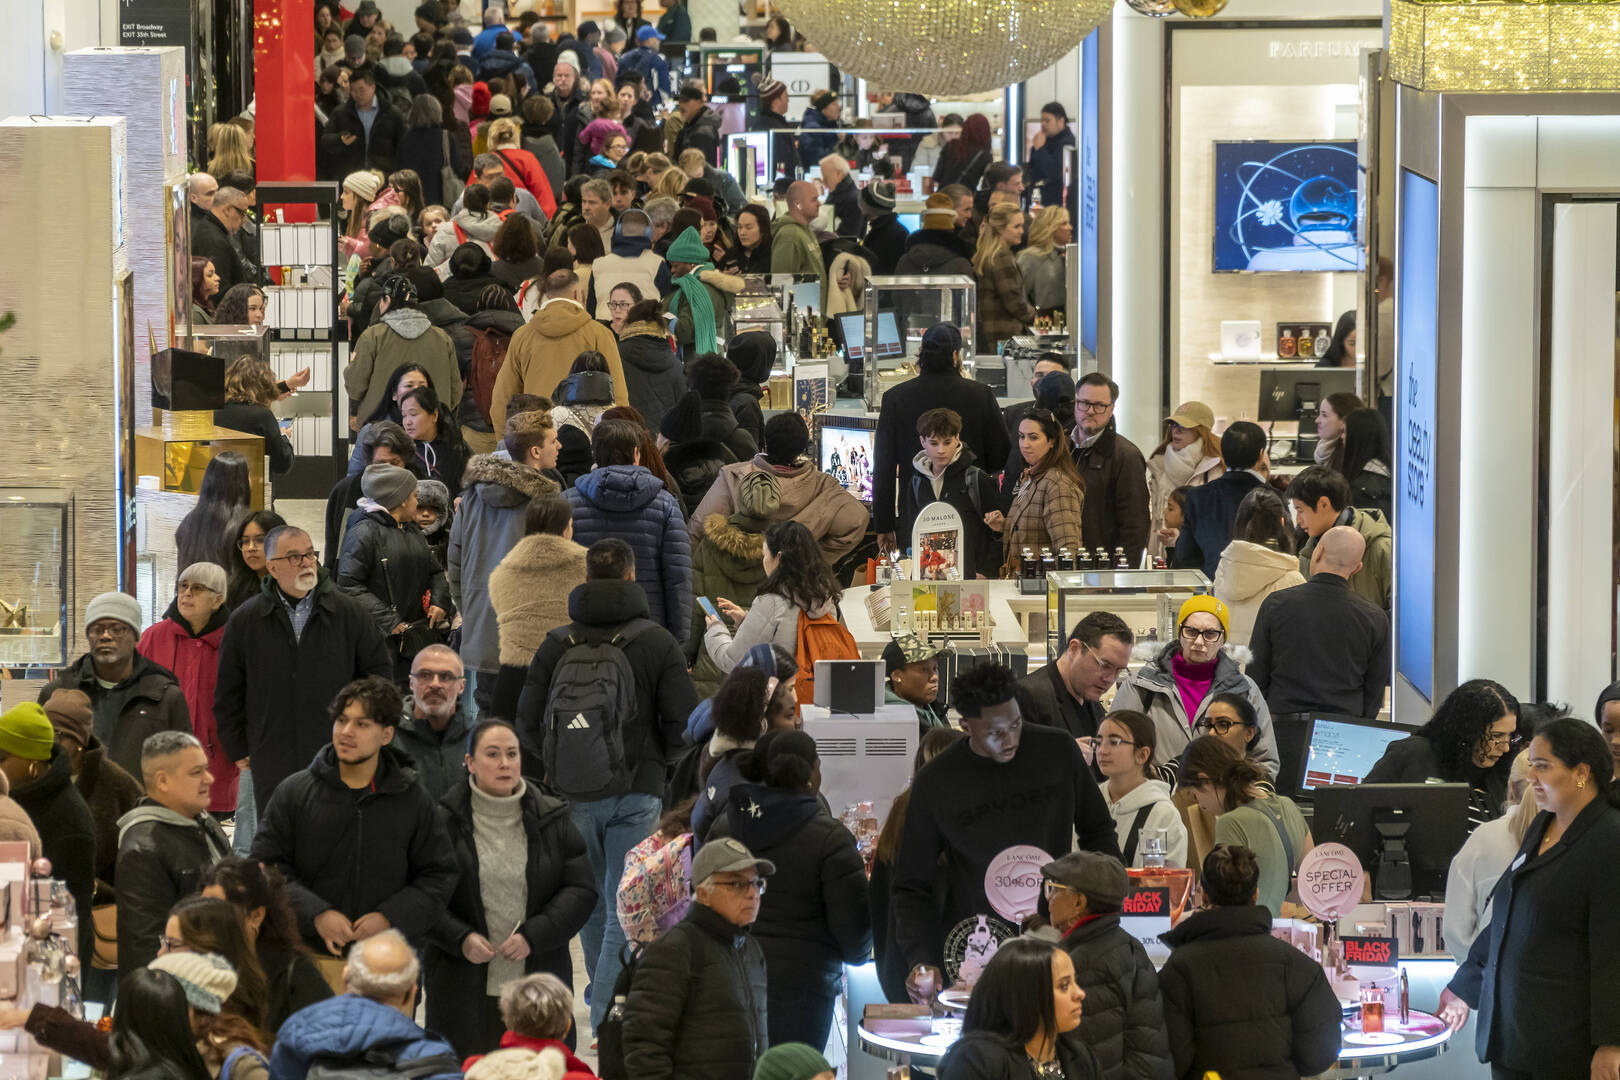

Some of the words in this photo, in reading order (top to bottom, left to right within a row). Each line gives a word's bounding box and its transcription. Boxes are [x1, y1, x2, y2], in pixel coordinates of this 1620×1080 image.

[1408, 361, 1418, 409] the
[1407, 405, 1431, 481] beauty
[1407, 460, 1425, 509] store
[1305, 869, 1358, 882] SPECIAL
[1311, 881, 1353, 894] OFFER
[1123, 902, 1162, 913] RIDAY
[1345, 941, 1391, 953] BLACK
[1346, 951, 1391, 963] FRIDAY
